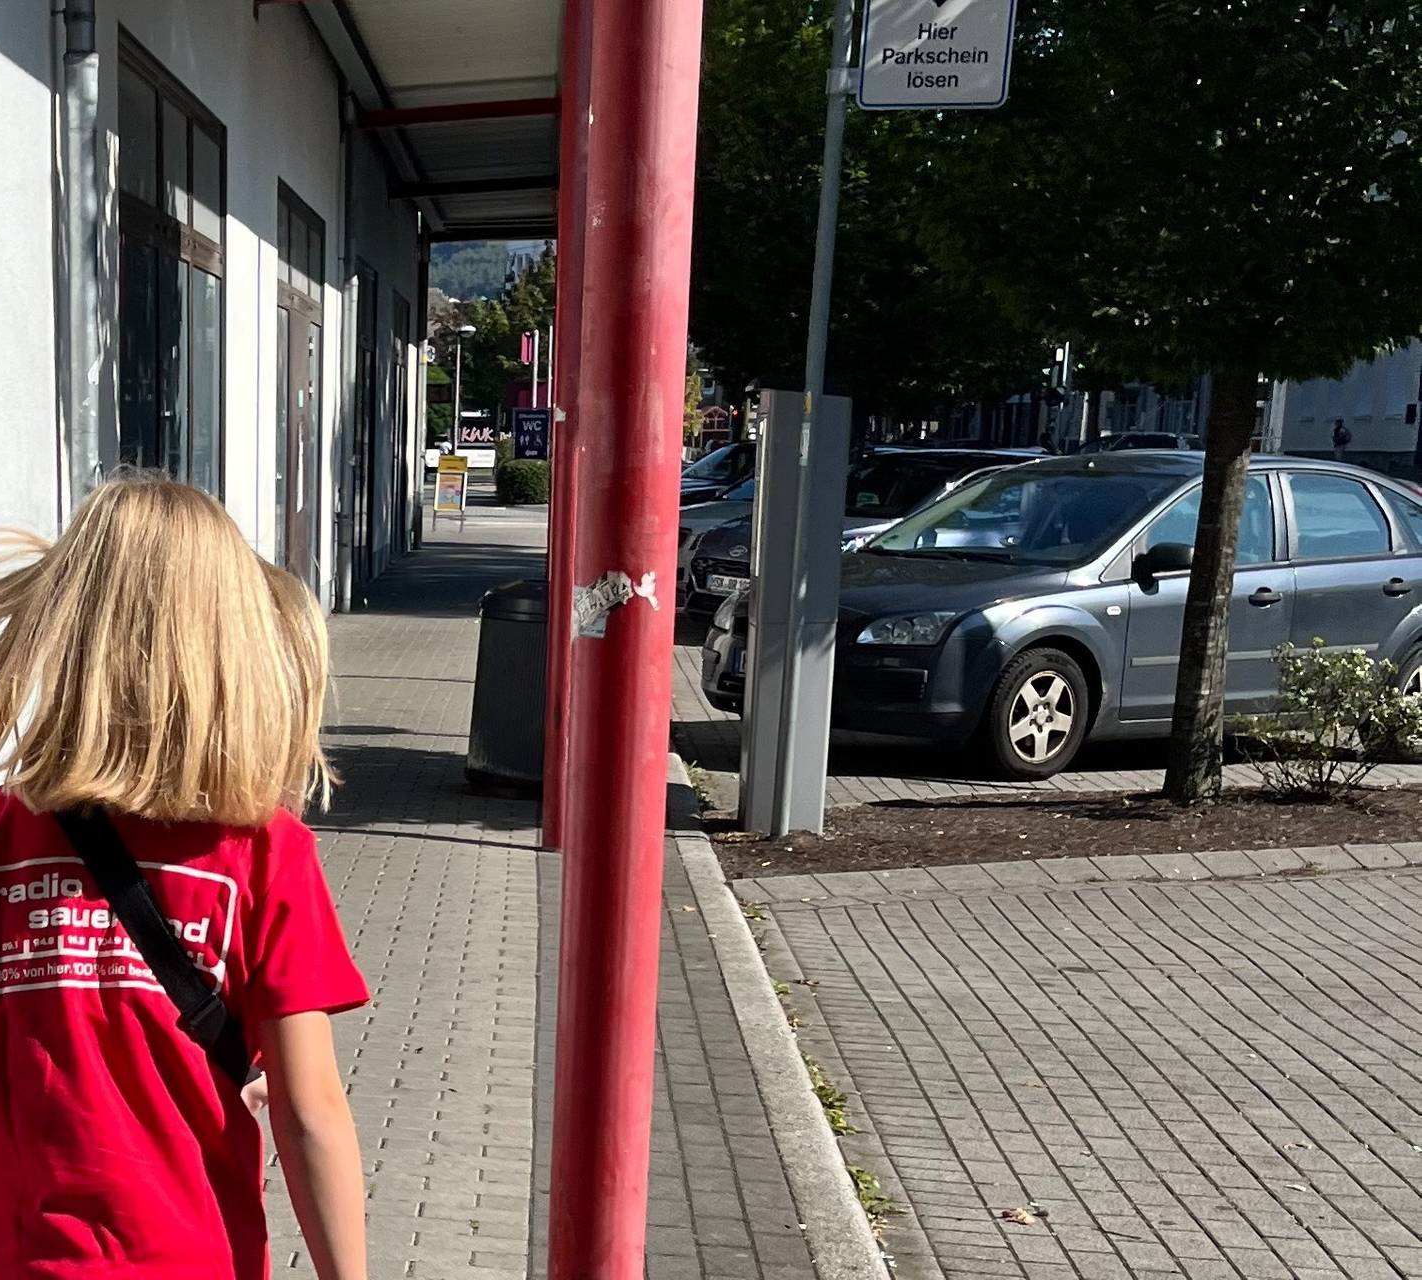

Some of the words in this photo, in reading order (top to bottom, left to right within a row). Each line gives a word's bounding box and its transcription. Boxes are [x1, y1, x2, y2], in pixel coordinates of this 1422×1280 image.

[918, 23, 958, 40] Hier
[881, 47, 989, 64] Parkschein
[906, 71, 959, 88] lösen
[522, 420, 543, 432] WC
[23, 966, 45, 978] von
[47, 962, 73, 975] hier.
[108, 963, 126, 976] die
